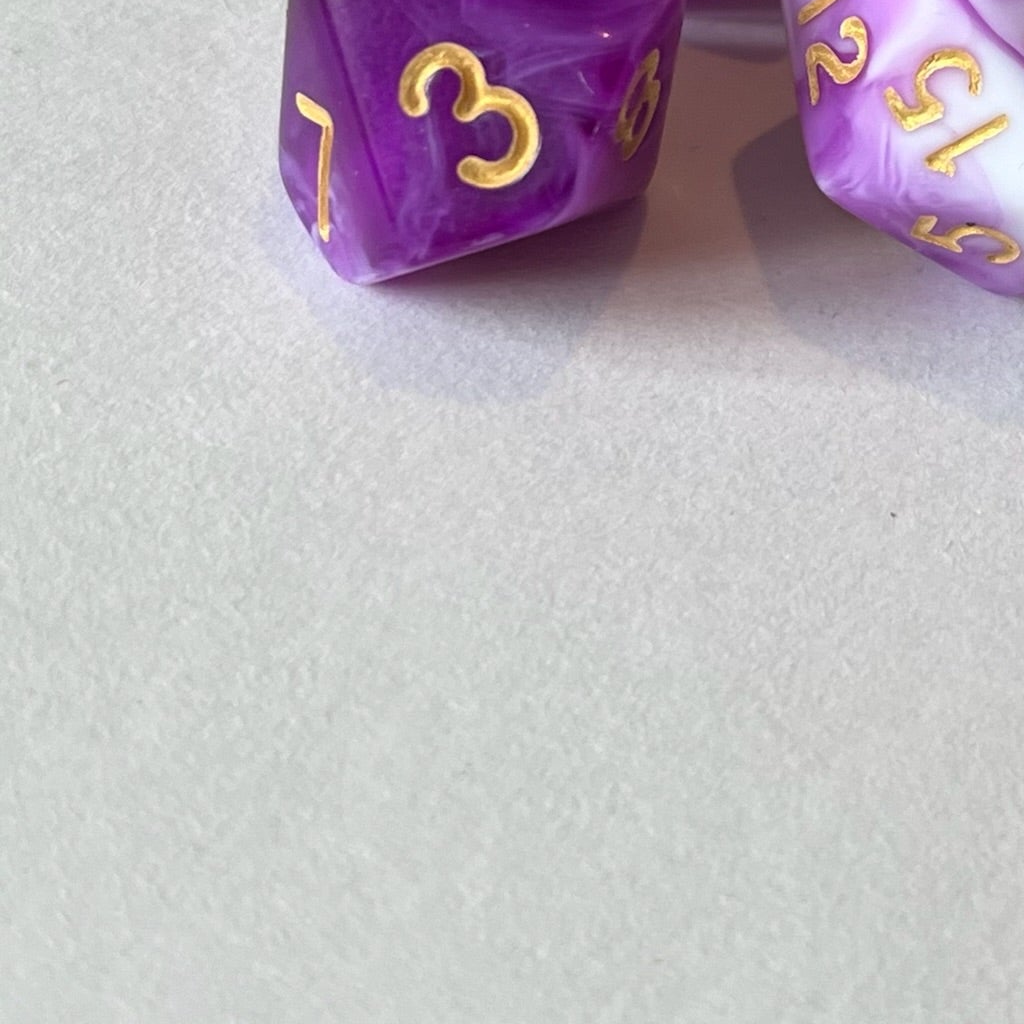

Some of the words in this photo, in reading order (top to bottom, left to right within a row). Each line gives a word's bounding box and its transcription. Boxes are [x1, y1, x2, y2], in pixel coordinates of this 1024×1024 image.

[295, 92, 334, 242] 7
[398, 42, 541, 189] 3
[884, 48, 1010, 176] 15
[911, 215, 1020, 264] 5
